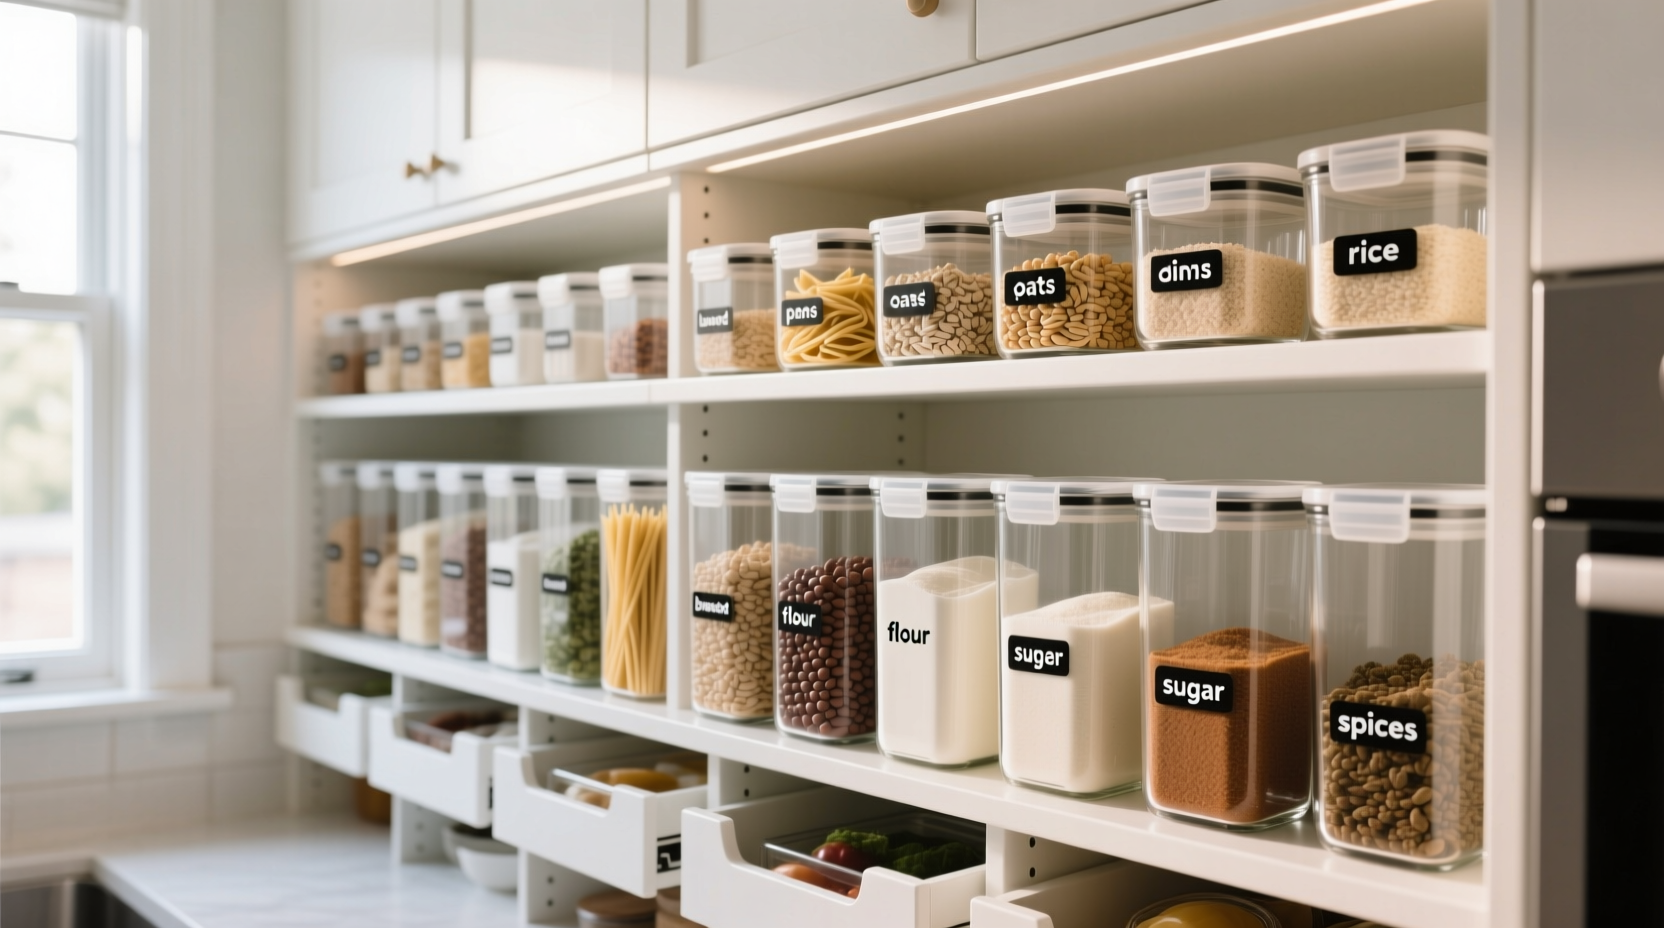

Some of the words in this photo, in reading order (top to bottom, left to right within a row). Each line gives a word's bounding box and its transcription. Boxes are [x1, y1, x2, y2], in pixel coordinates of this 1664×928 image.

[1349, 239, 1400, 265] rice
[782, 606, 816, 628] flour
[888, 621, 931, 645] flour
[1162, 678, 1226, 706] sugar
[1337, 711, 1418, 742] spices
